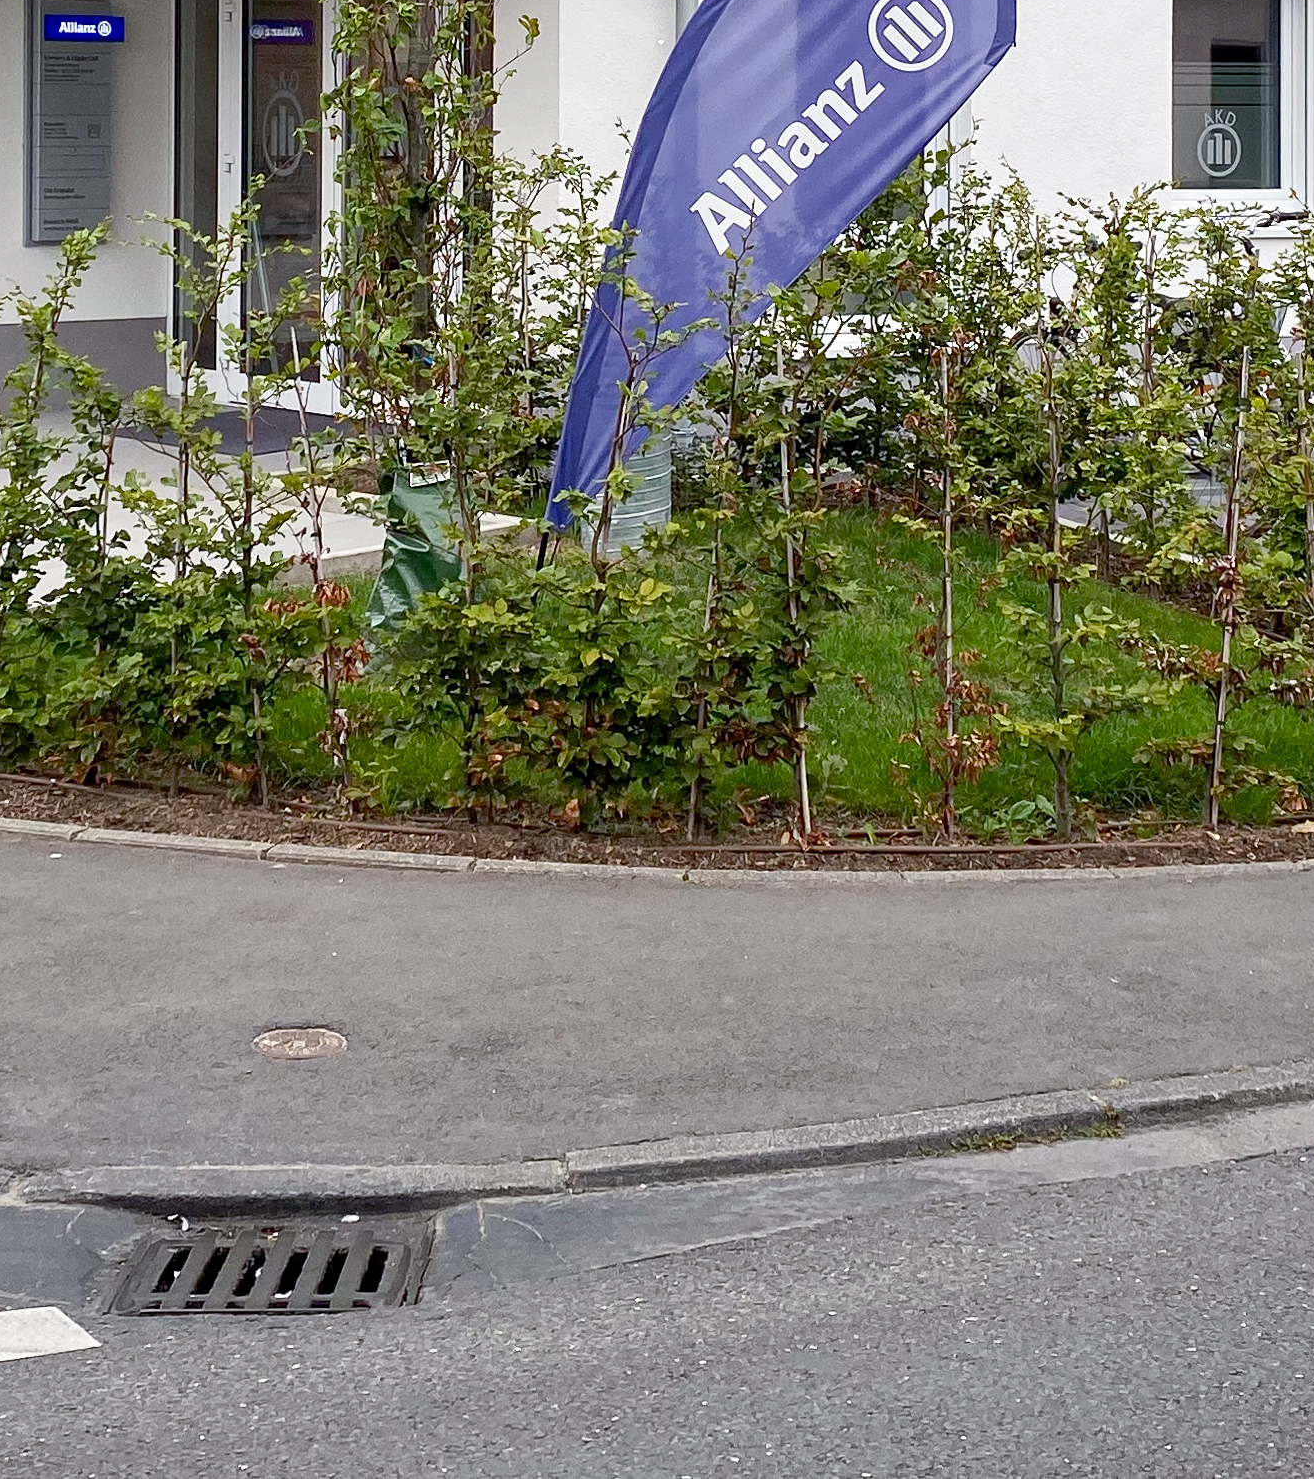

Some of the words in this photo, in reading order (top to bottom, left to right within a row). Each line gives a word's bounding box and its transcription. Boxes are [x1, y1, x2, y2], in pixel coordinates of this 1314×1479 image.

[58, 21, 97, 34] Allianz
[1204, 108, 1237, 128] AKD
[688, 59, 886, 256] Allianz
